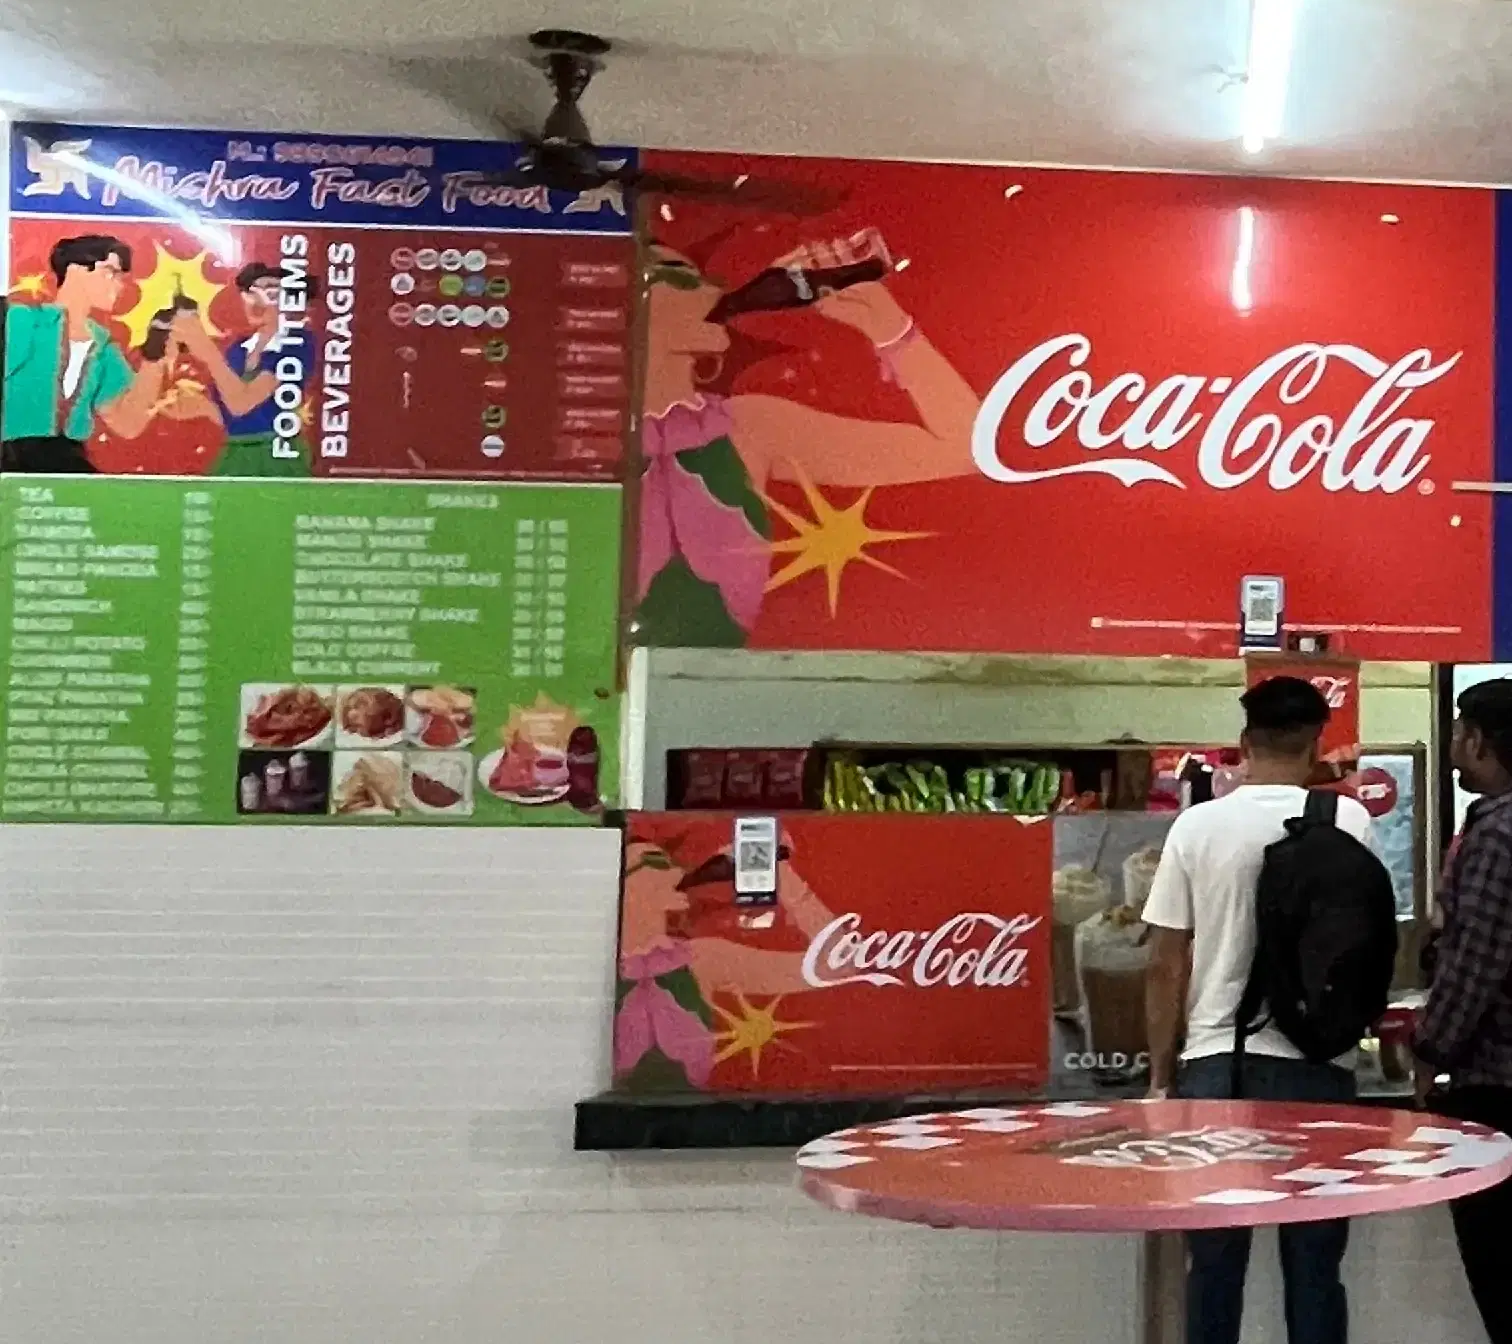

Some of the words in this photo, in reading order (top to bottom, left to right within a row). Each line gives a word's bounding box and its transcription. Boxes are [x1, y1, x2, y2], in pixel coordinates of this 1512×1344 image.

[101, 155, 299, 207] Mishra
[309, 167, 432, 211] Fast
[277, 234, 309, 348] ITEMS
[321, 242, 355, 458] BEVERAGES
[272, 356, 303, 458] FOOD
[971, 333, 1462, 493] Coca-Cola
[802, 912, 1043, 988] Coca-Cola
[1063, 1052, 1127, 1069] COLD
